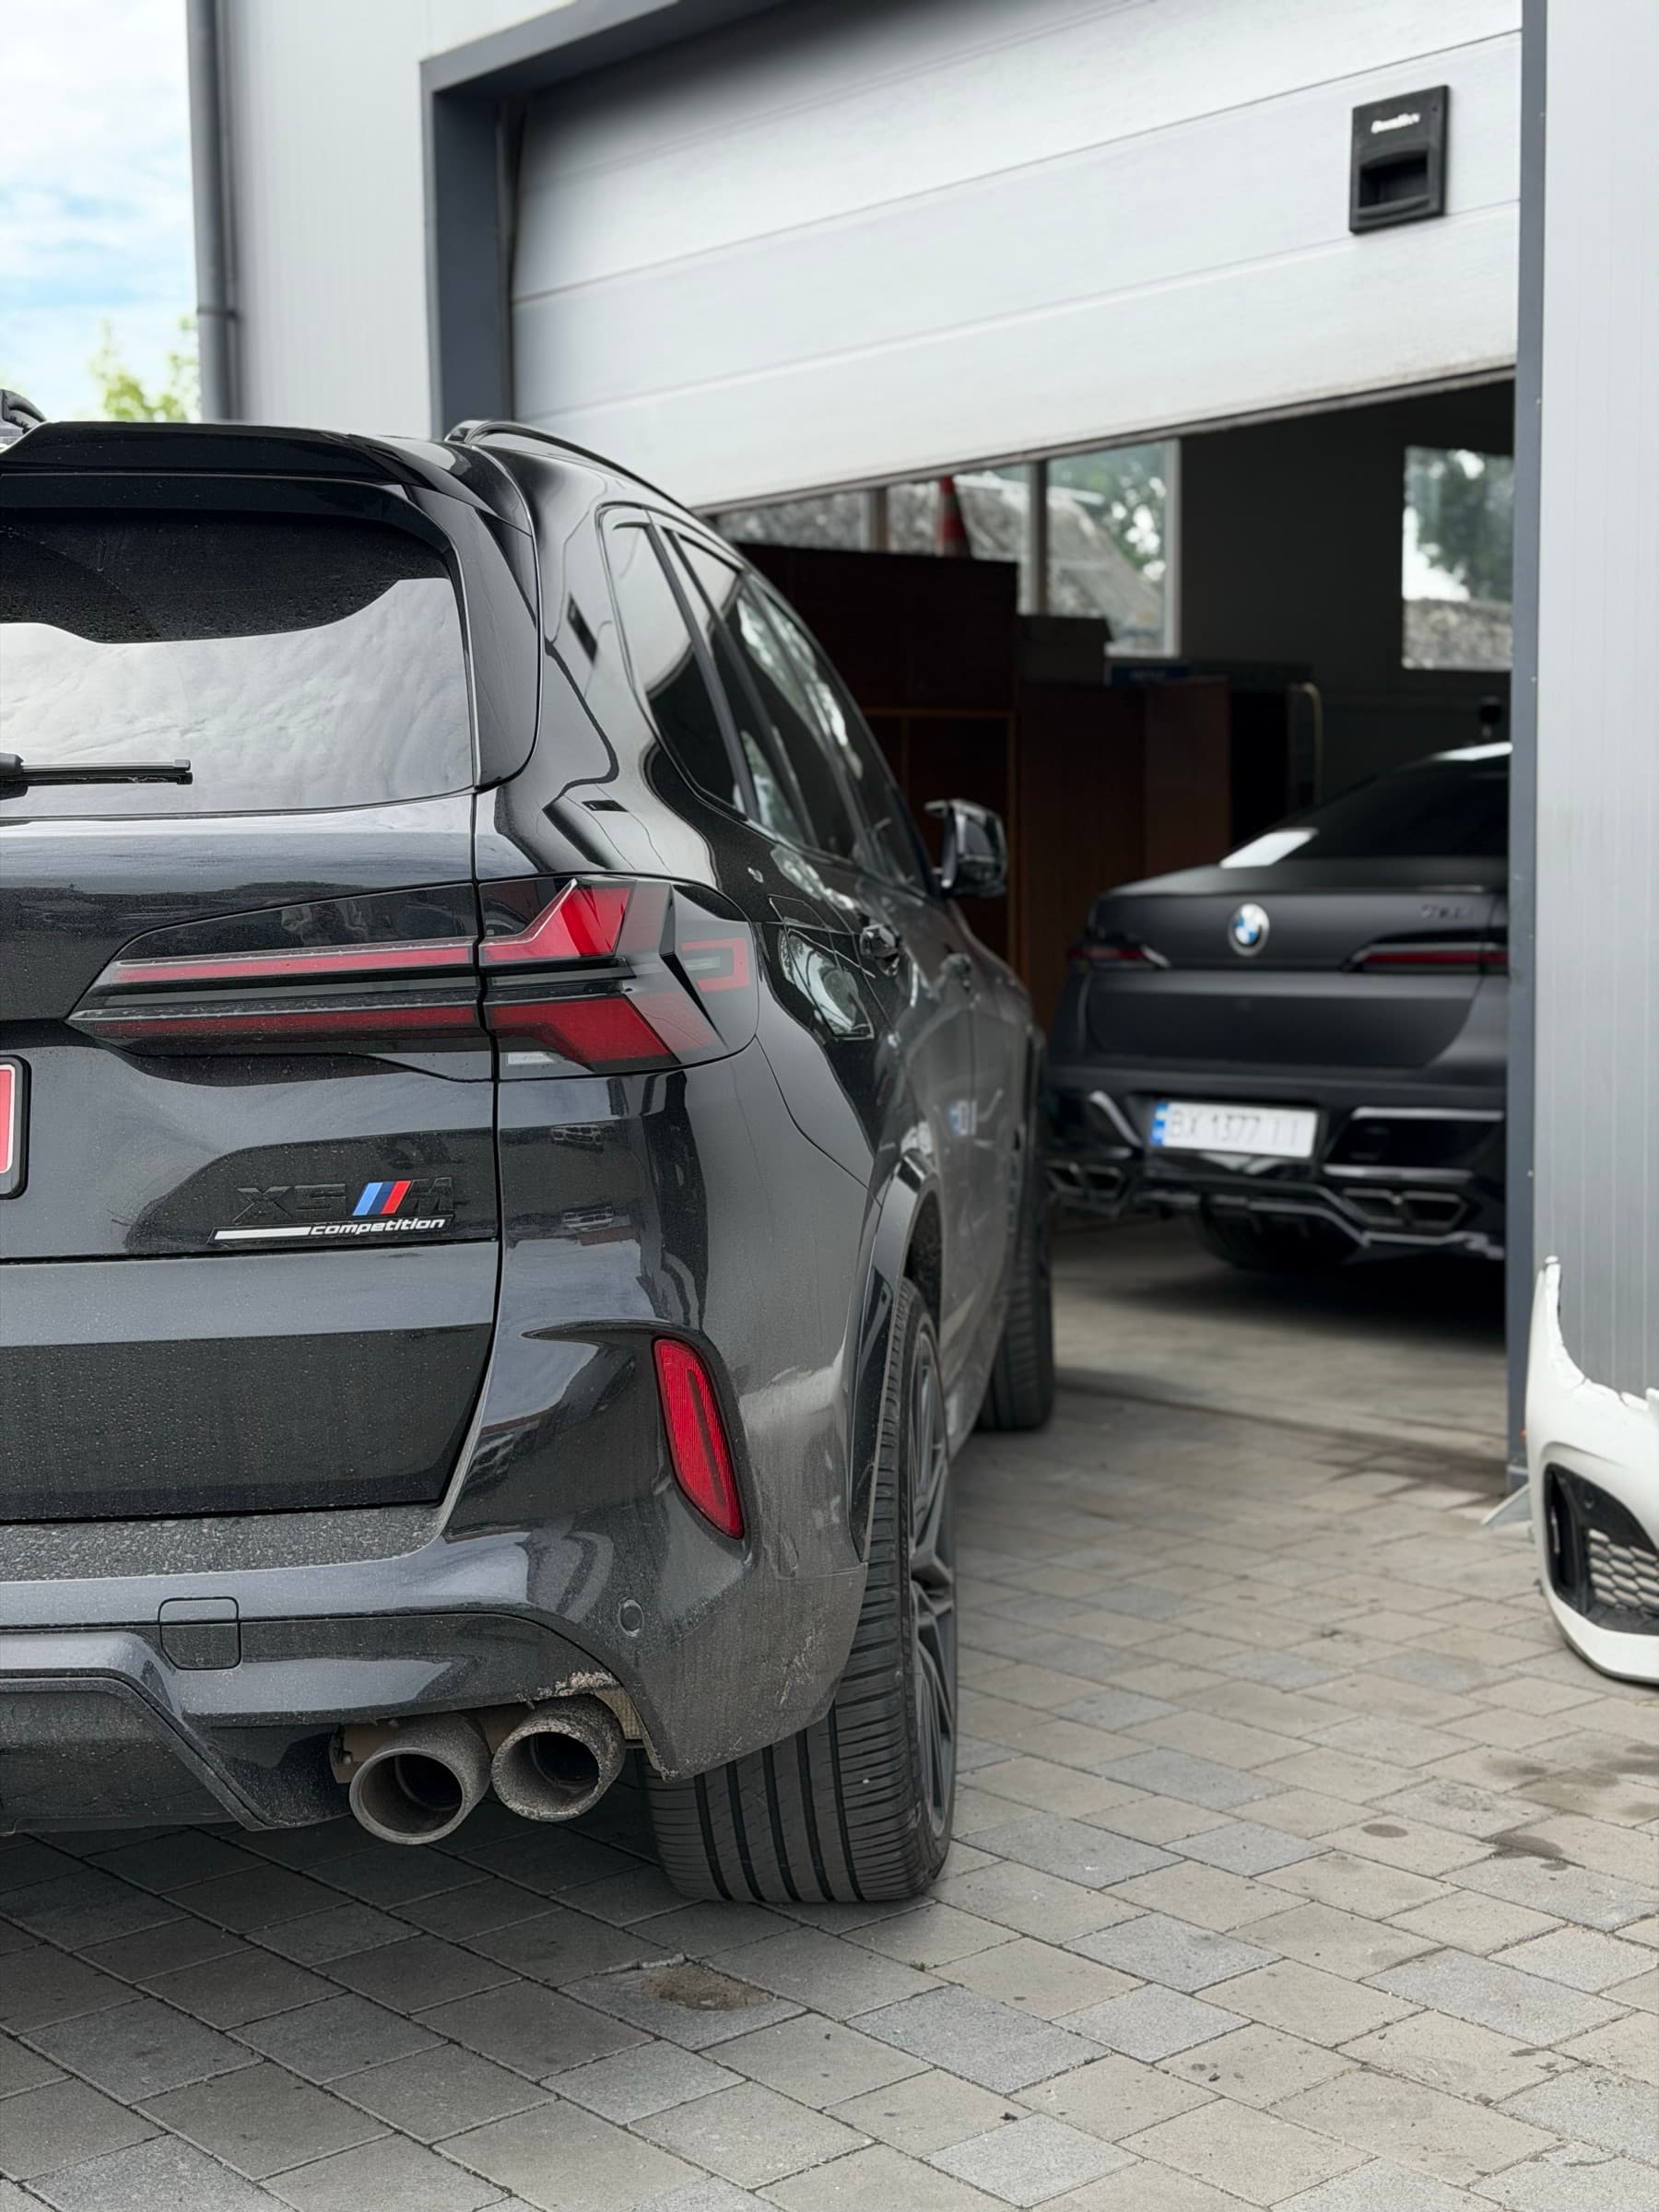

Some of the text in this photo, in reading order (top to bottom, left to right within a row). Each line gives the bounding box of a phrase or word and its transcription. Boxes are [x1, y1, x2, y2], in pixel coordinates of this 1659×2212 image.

[1211, 1112, 1261, 1143] 1377
[232, 1183, 347, 1225] X5
[309, 1218, 445, 1238] competition
